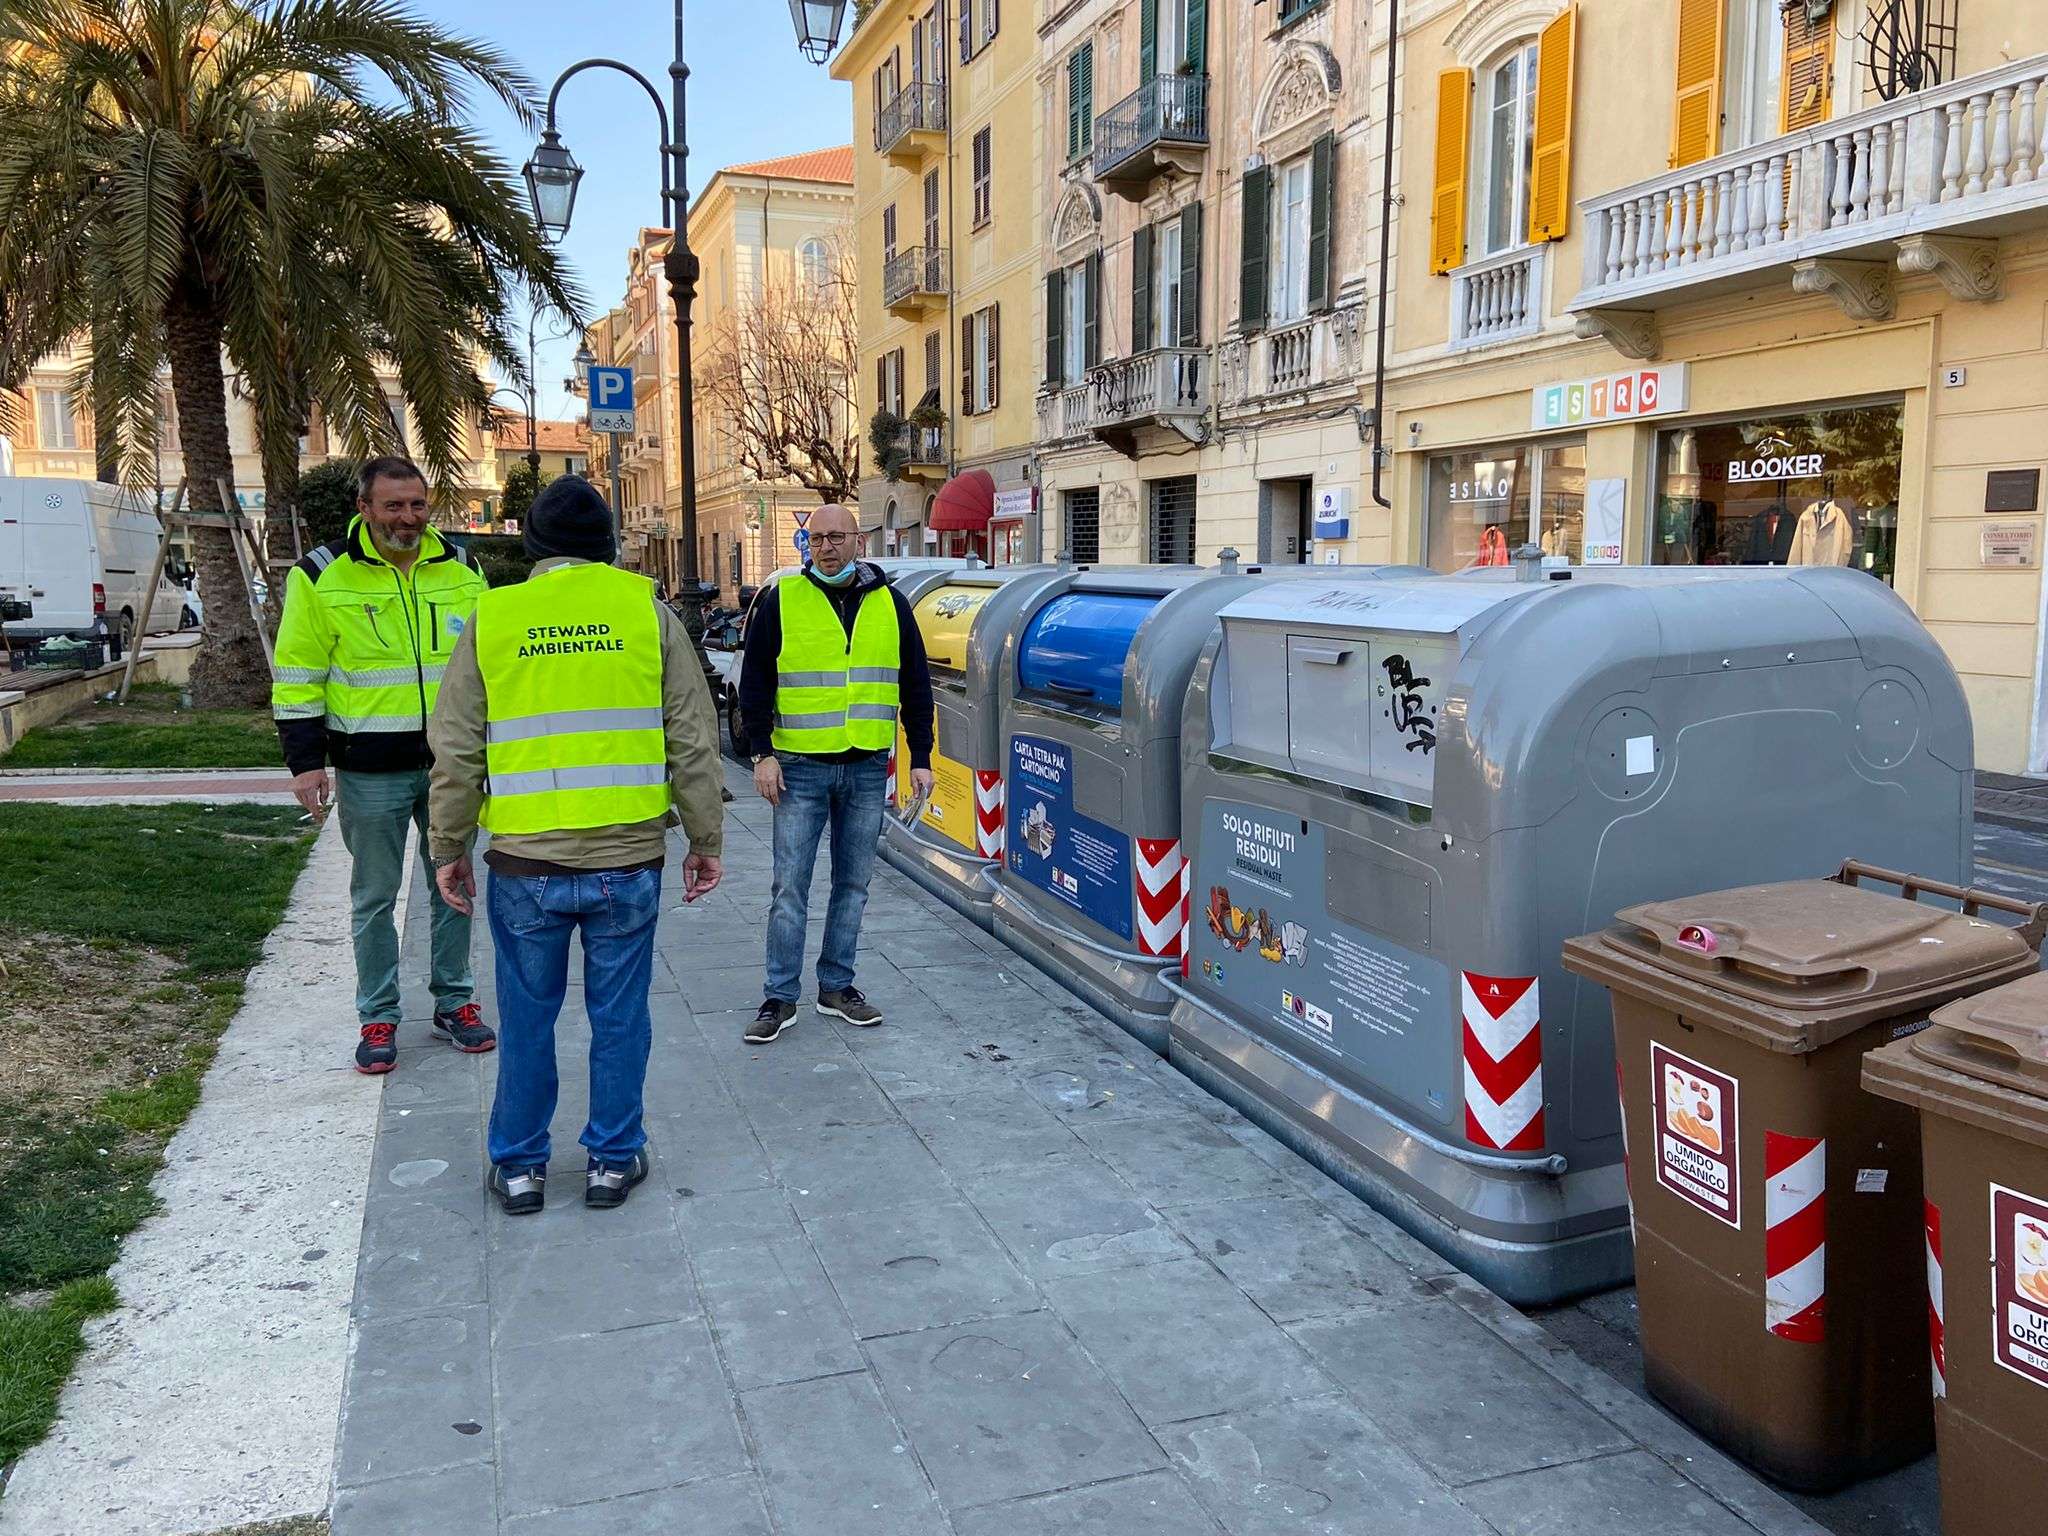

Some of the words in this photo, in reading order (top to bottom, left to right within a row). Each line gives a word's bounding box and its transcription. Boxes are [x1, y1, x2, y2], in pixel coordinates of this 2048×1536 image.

[598, 371, 625, 405] P
[1949, 371, 1958, 383] 5
[1728, 454, 1823, 480] BLOOKER
[527, 624, 610, 640] STEWARD
[518, 639, 624, 658] AMBIENTALE
[1014, 740, 1033, 760] CARTA
[1033, 746, 1052, 765] TETRA
[1020, 757, 1060, 783] CARTONCINO
[1222, 813, 1252, 837] SOLO
[1254, 822, 1295, 853] RIFIUTI
[1236, 837, 1281, 869] RESIDUI
[1675, 1142, 1714, 1171] UMIDO
[1666, 1151, 1725, 1190] ORGANICO
[1674, 1173, 1718, 1202] BIOWASTE
